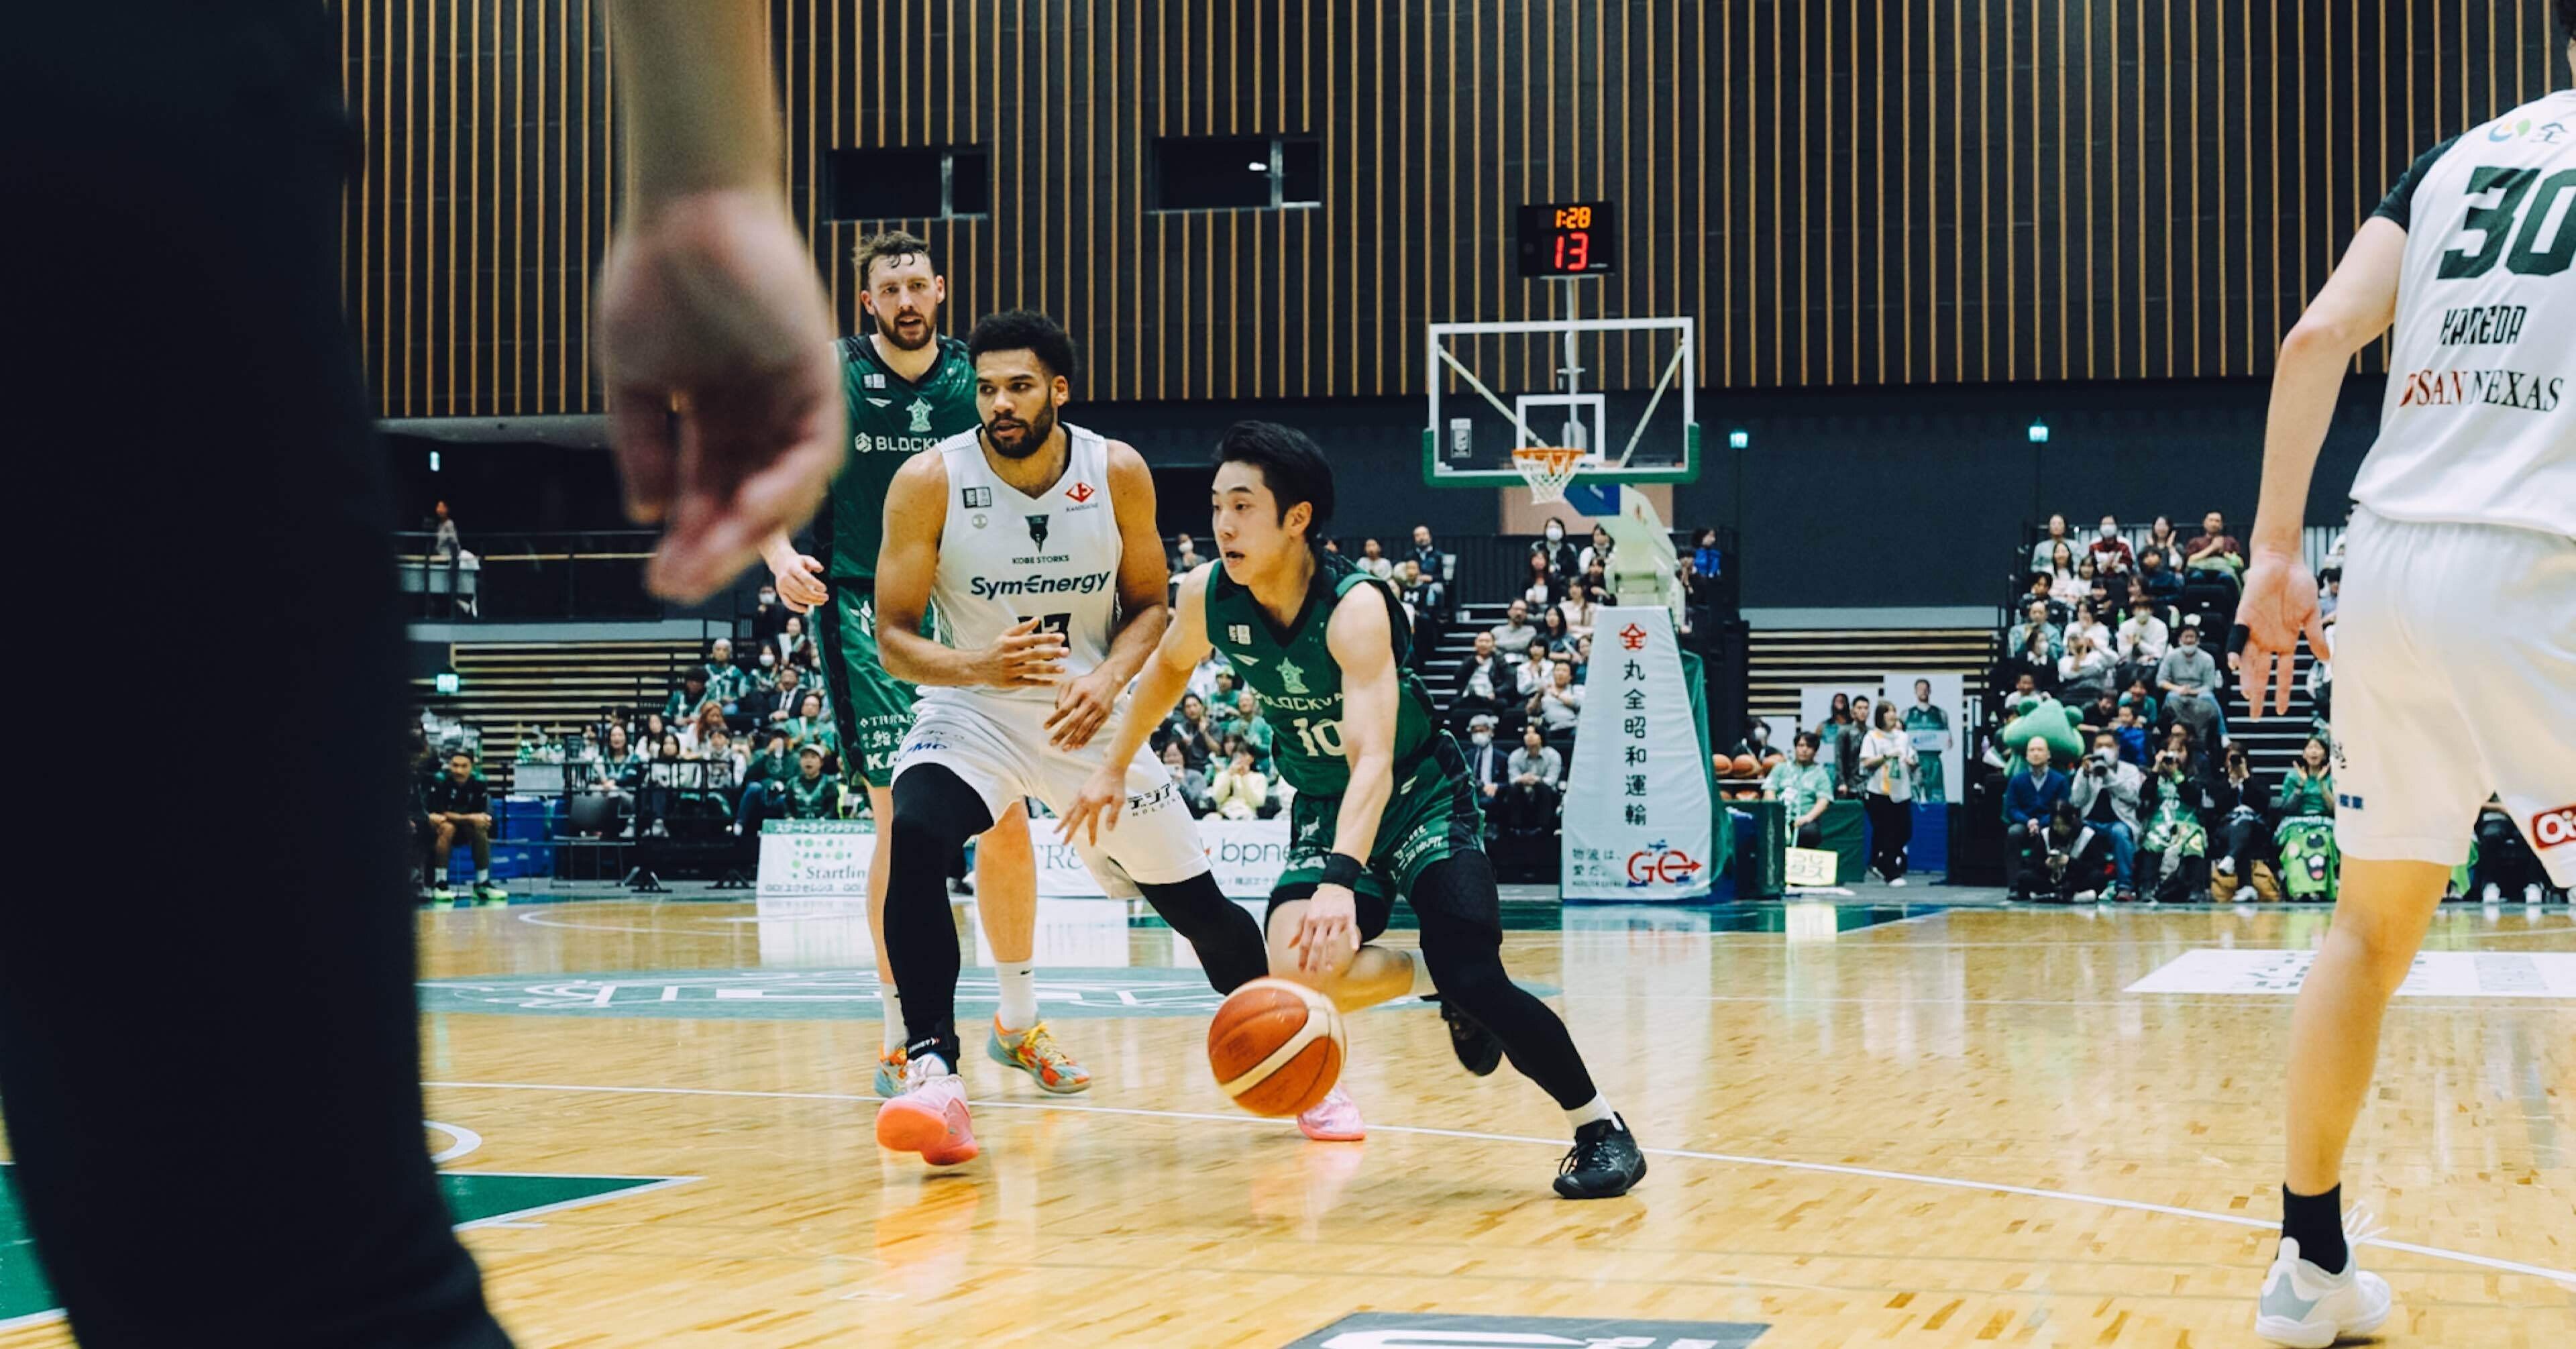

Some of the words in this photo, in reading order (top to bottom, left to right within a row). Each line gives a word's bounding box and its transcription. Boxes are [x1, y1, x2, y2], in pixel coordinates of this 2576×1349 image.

[1555, 206, 1592, 229] 1:28
[2437, 166, 2576, 280] 30
[1554, 231, 1589, 270] 13
[1012, 556, 1034, 564] KOBE
[1036, 555, 1070, 563] STORKS
[1293, 717, 1346, 757] 10
[1623, 658, 1648, 826] 丸全昭和運輸
